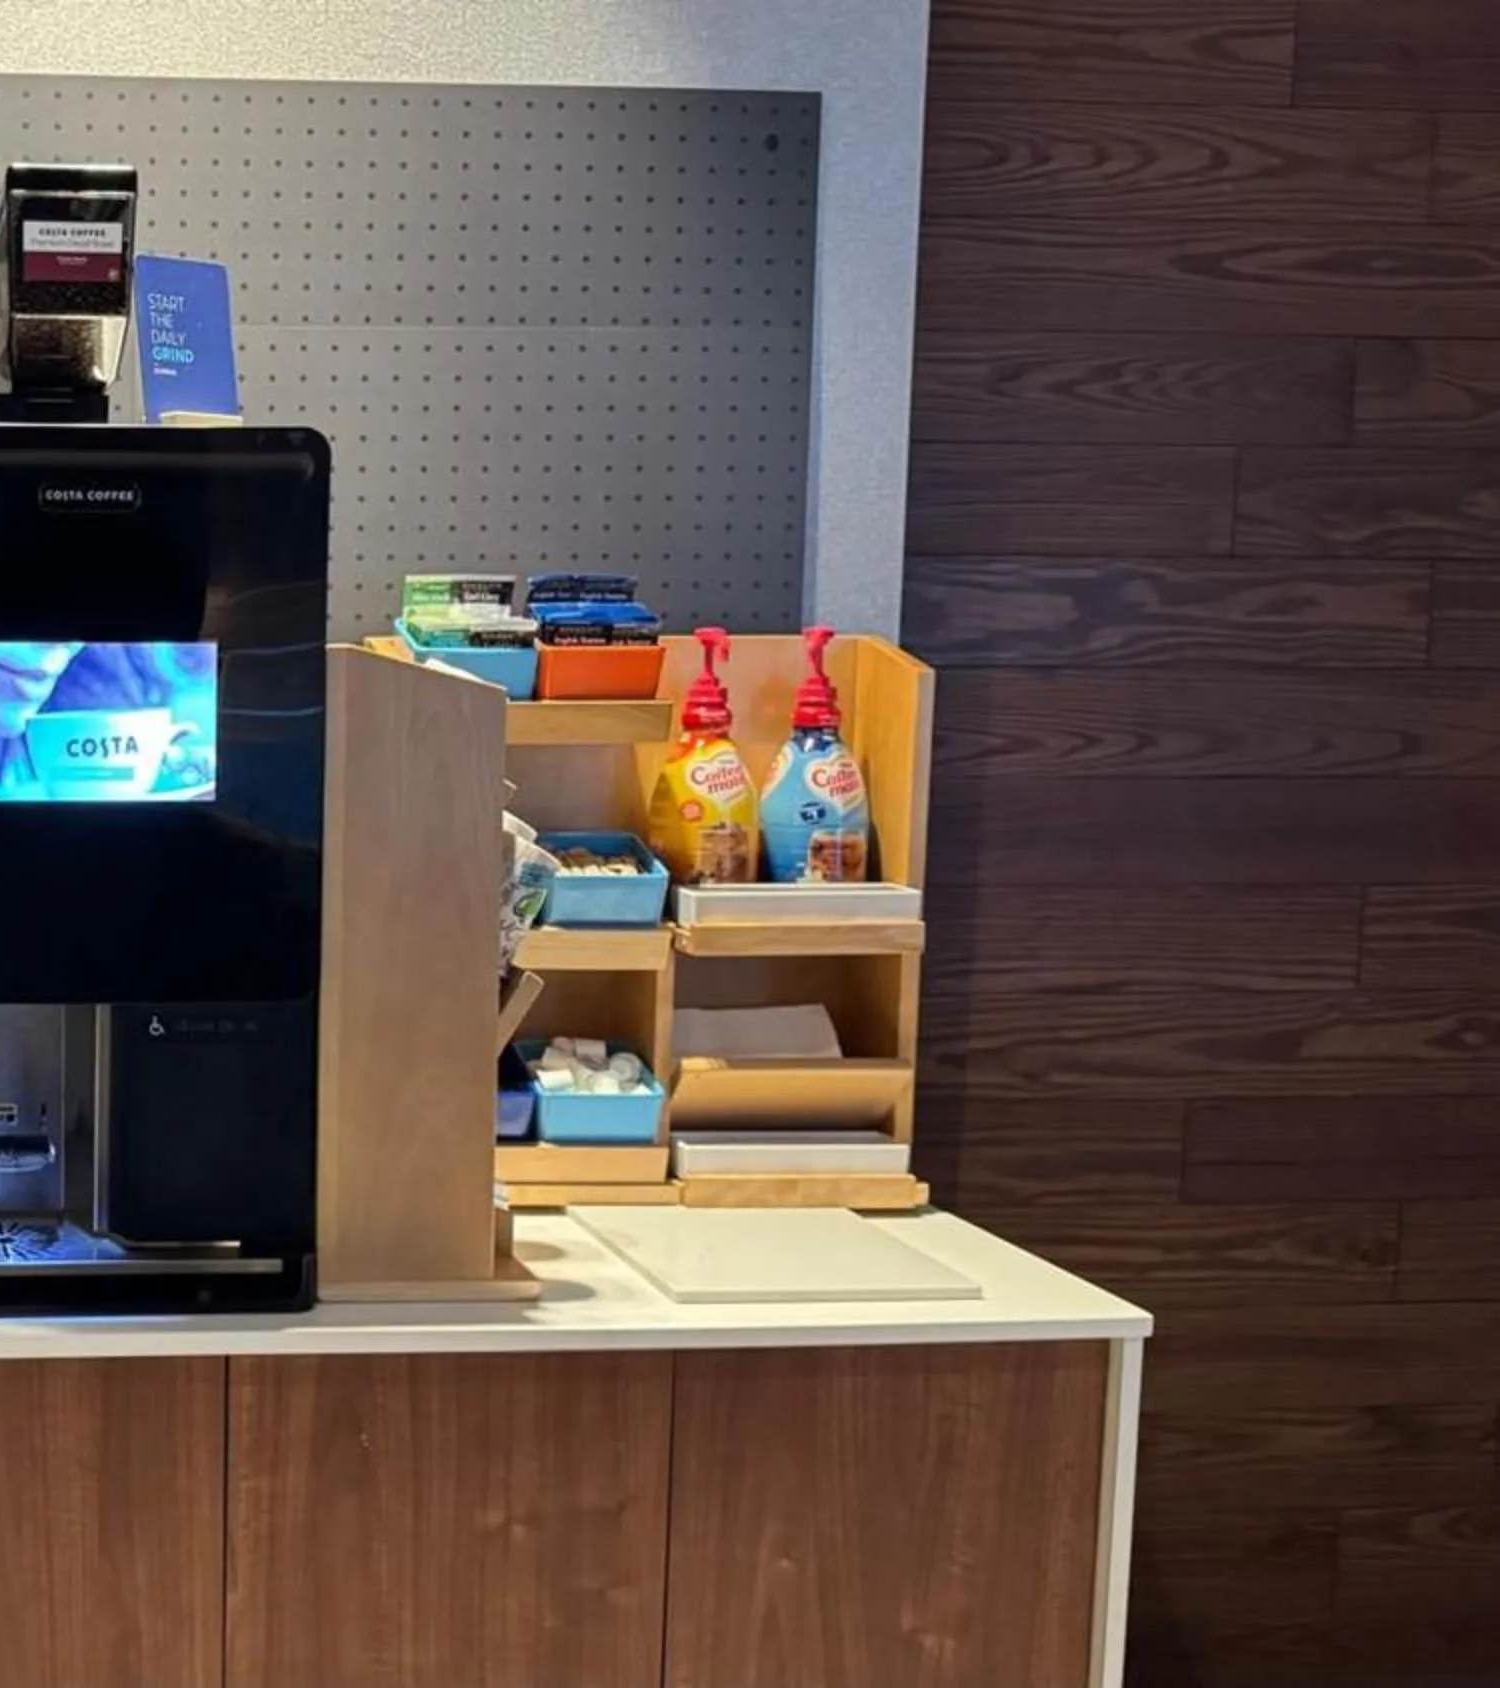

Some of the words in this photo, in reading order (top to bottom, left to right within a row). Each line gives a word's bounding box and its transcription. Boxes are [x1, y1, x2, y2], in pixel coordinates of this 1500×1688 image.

[70, 228, 106, 237] COFFEE
[148, 293, 185, 313] START
[150, 312, 173, 329] THE
[151, 329, 187, 346] DAILY
[152, 346, 195, 364] GRIND
[44, 488, 84, 501] COSTA
[87, 489, 134, 501] COFFEE
[65, 735, 140, 758] COSTA
